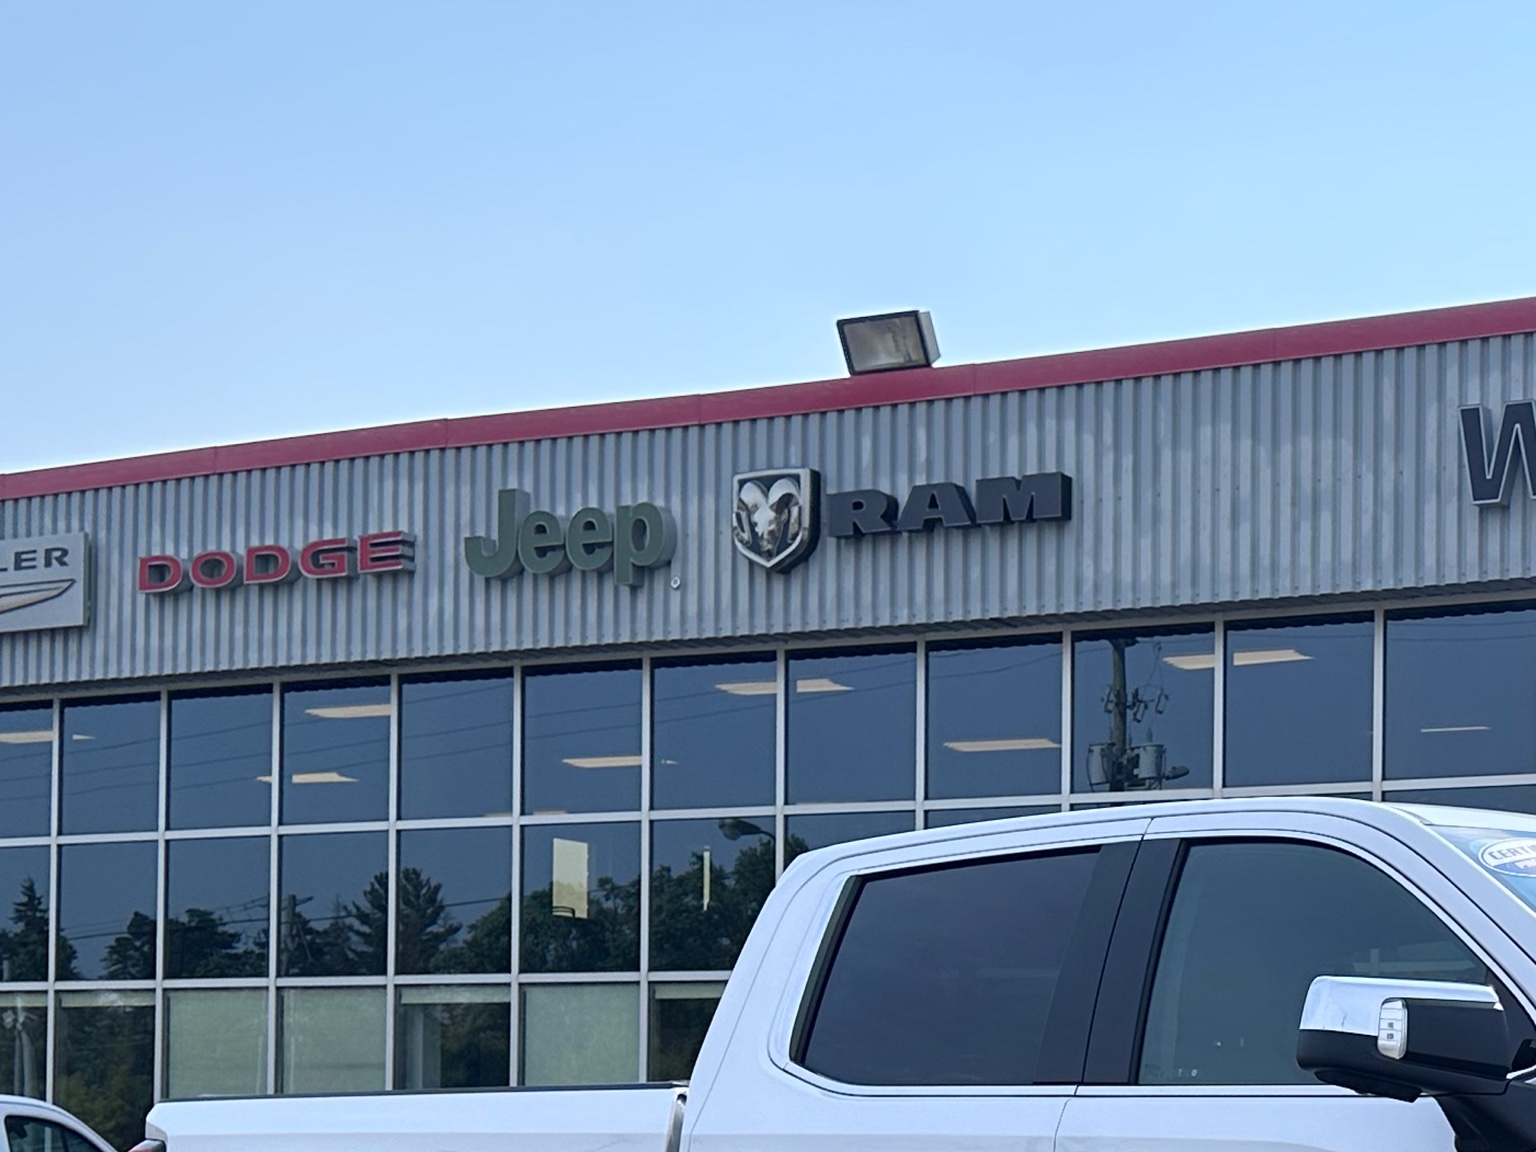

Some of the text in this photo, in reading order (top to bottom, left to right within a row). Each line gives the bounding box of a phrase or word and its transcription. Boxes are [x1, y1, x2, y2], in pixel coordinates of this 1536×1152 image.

[464, 488, 676, 588] Jeep
[826, 471, 1072, 538] RAM
[138, 530, 416, 594] DODGE
